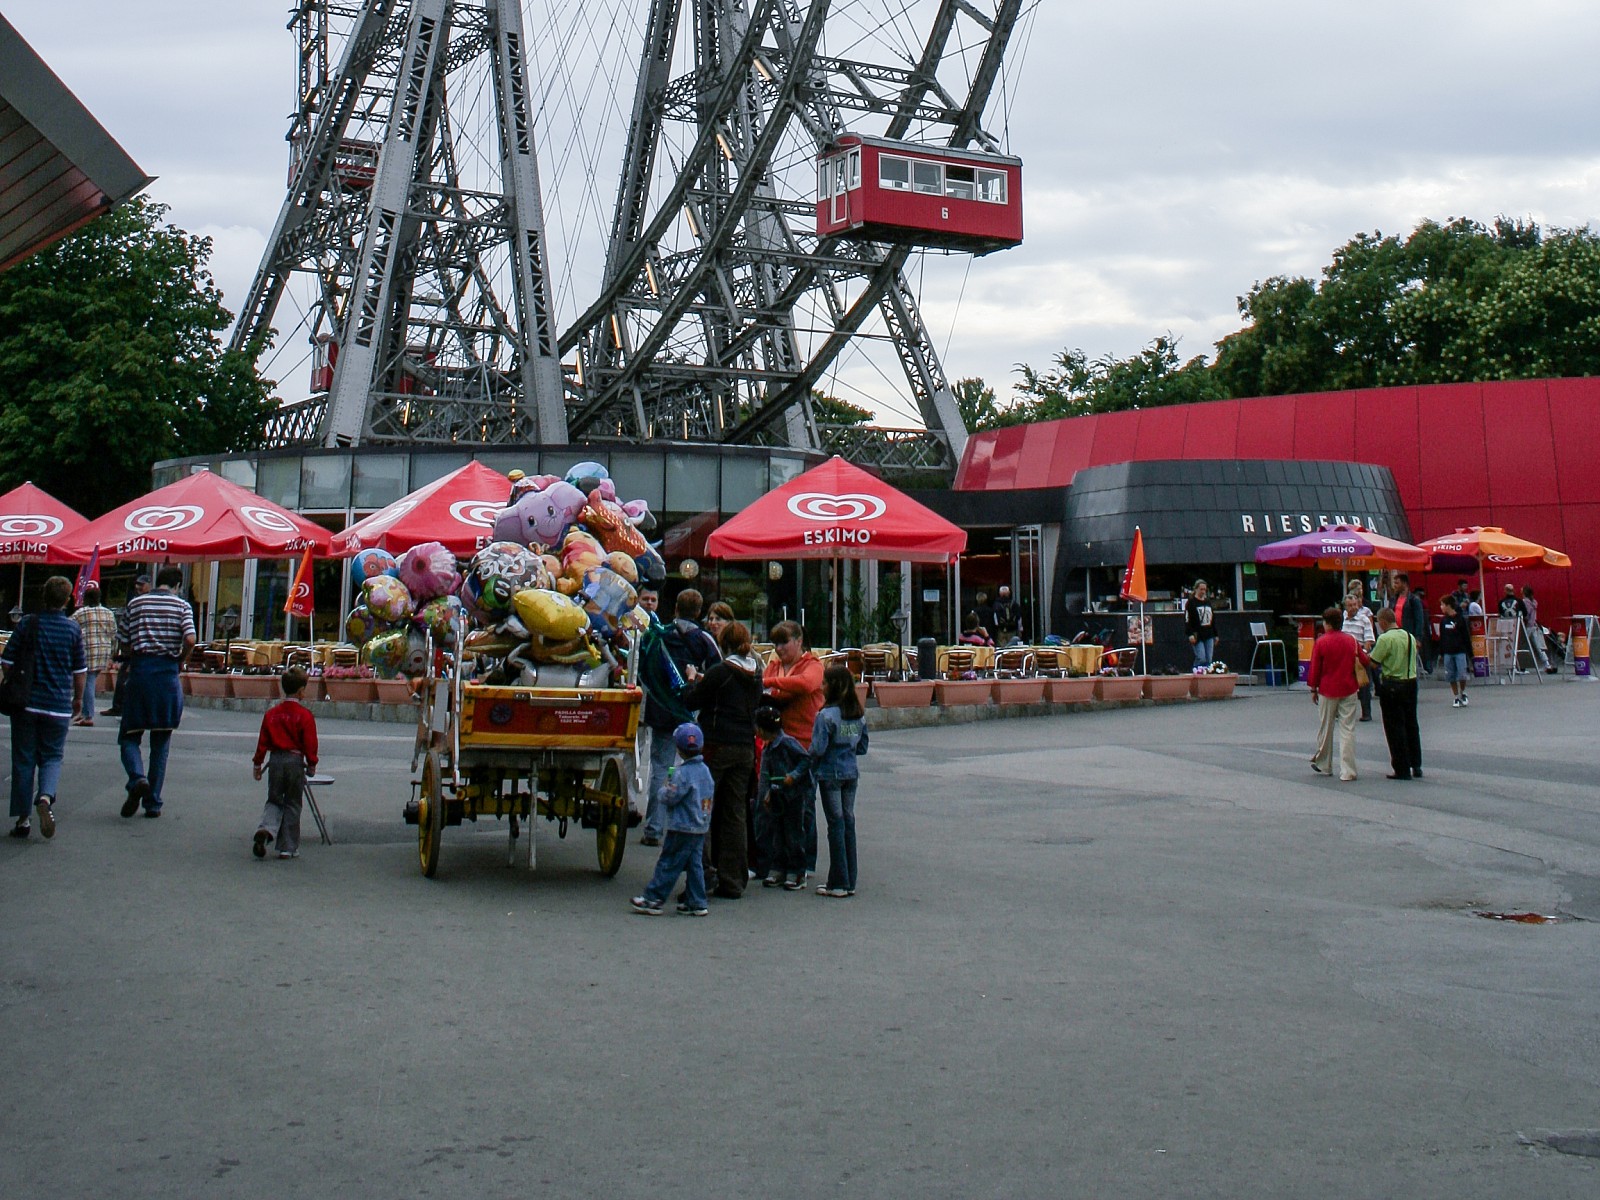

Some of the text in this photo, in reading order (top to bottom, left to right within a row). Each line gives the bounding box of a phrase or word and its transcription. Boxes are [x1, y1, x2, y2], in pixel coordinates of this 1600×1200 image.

[941, 207, 949, 219] 6
[803, 528, 871, 545] ESKIMO
[116, 538, 168, 554] ESKIMO
